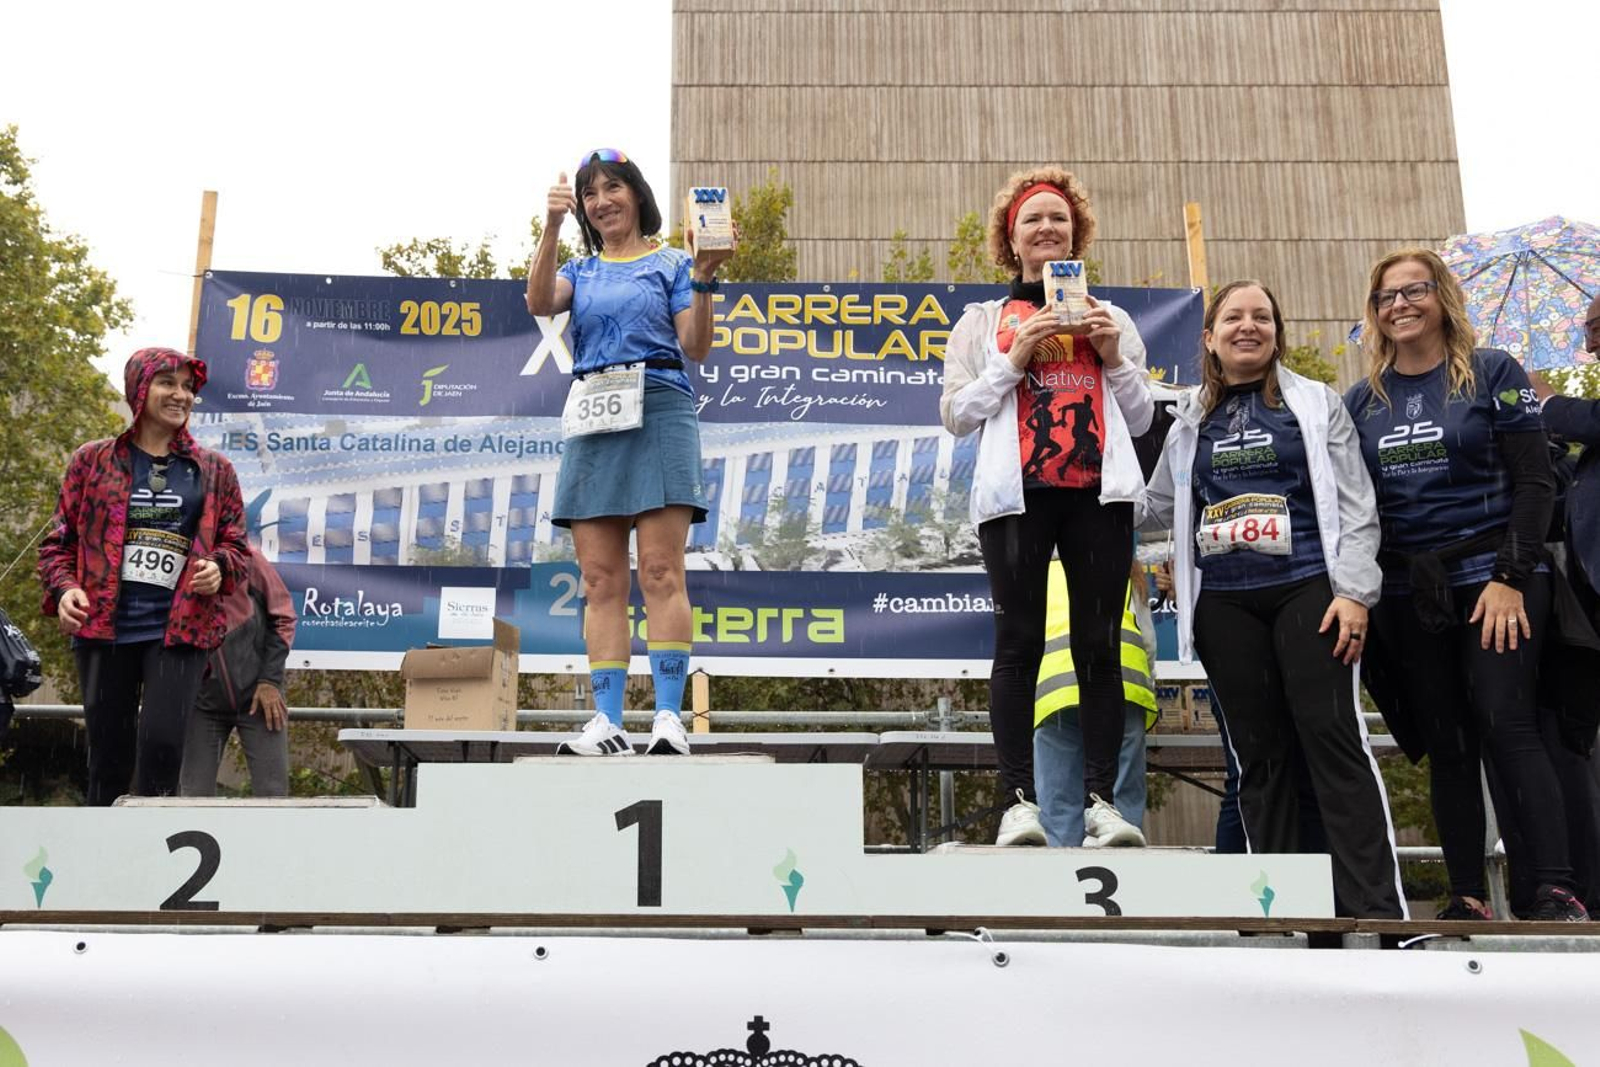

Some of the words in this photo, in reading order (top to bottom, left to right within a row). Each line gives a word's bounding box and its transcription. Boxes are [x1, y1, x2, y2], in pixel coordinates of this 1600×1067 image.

[694, 188, 727, 204] XXV
[1049, 262, 1083, 278] XXV
[227, 294, 285, 342] 16
[290, 298, 391, 319] NOVIEMBRE
[400, 301, 482, 337] 2025
[313, 321, 337, 329] partir
[350, 322, 361, 330] las
[364, 323, 391, 331] 11:00h
[700, 365, 719, 383] y
[730, 365, 801, 383] gran
[1028, 370, 1095, 390] Native
[355, 390, 390, 398] Andalucía
[696, 392, 714, 414] y
[721, 384, 746, 406] la
[753, 384, 887, 421] Integración
[578, 393, 622, 421] 356
[221, 433, 259, 451] IES
[267, 432, 331, 451] Santa
[340, 433, 435, 452] Catalina
[443, 434, 472, 453] de
[1213, 428, 1273, 453] 25
[1378, 421, 1444, 449] 25
[1212, 446, 1274, 461] CARRERA
[1378, 441, 1445, 457] CARRERA
[1380, 448, 1448, 465] POPULAR
[1212, 453, 1277, 468] POPULAR
[1410, 458, 1449, 467] caminata
[129, 488, 183, 508] 25
[128, 548, 175, 574] 496
[302, 587, 403, 626] Rotalaya
[447, 602, 488, 612] Sierras
[583, 605, 845, 643] terra
[614, 800, 663, 908] 1
[159, 829, 222, 912] 2
[1075, 866, 1123, 917] 3
